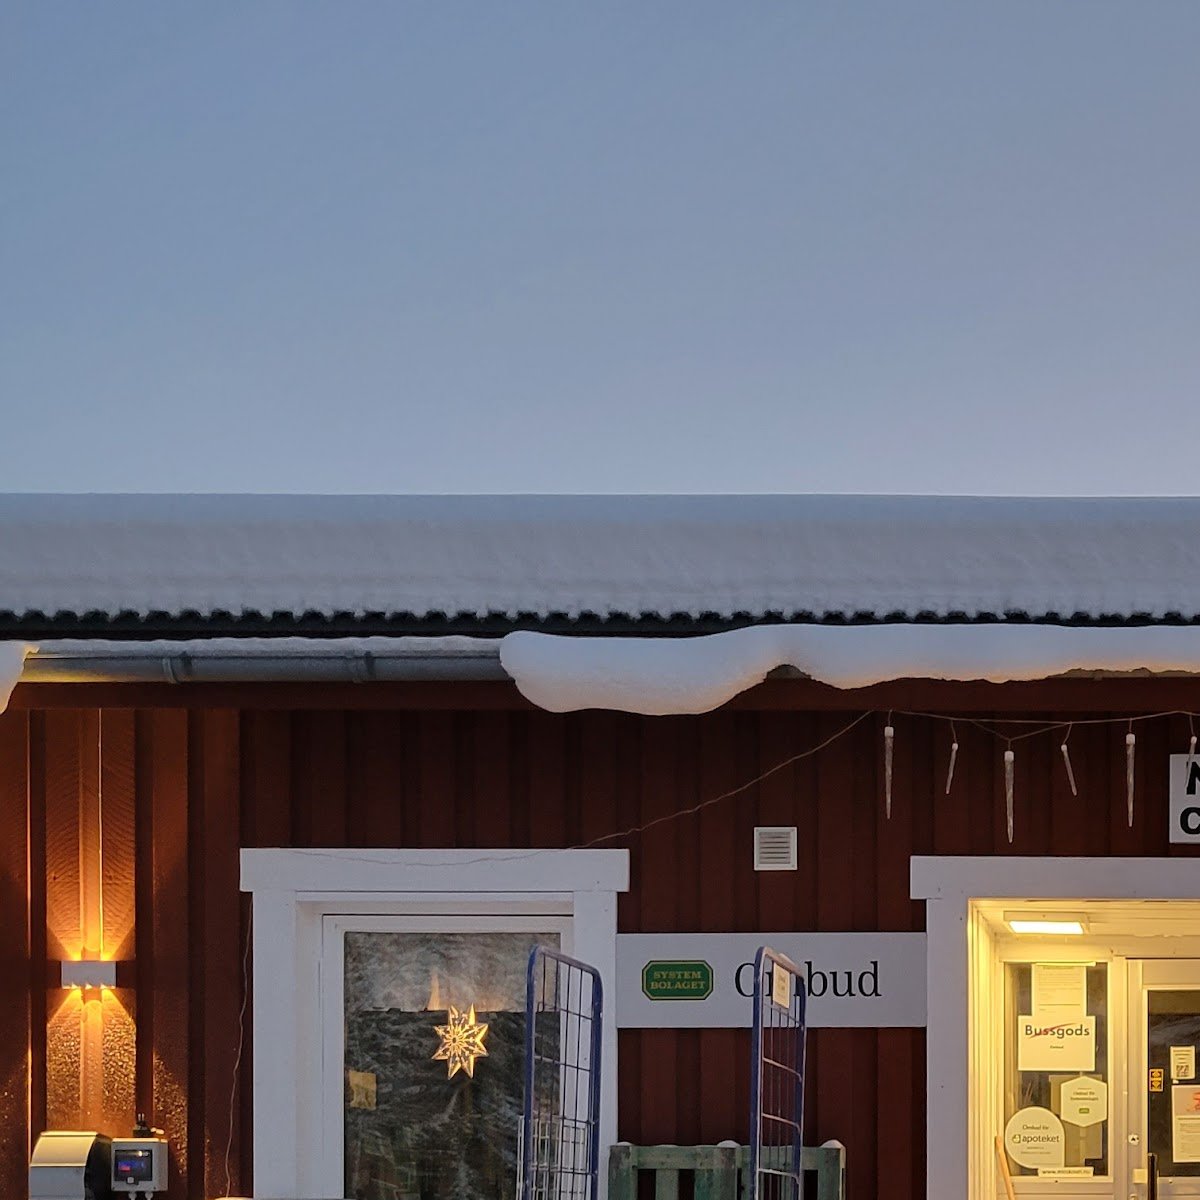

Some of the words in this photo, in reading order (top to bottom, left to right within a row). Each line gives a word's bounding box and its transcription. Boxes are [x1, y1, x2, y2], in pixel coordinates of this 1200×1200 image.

[653, 970, 703, 980] SYSTEM
[734, 960, 882, 998] Obud
[650, 981, 707, 990] BOLAGET
[1025, 1024, 1090, 1039] Bussgods
[1022, 1134, 1060, 1143] apoteket
